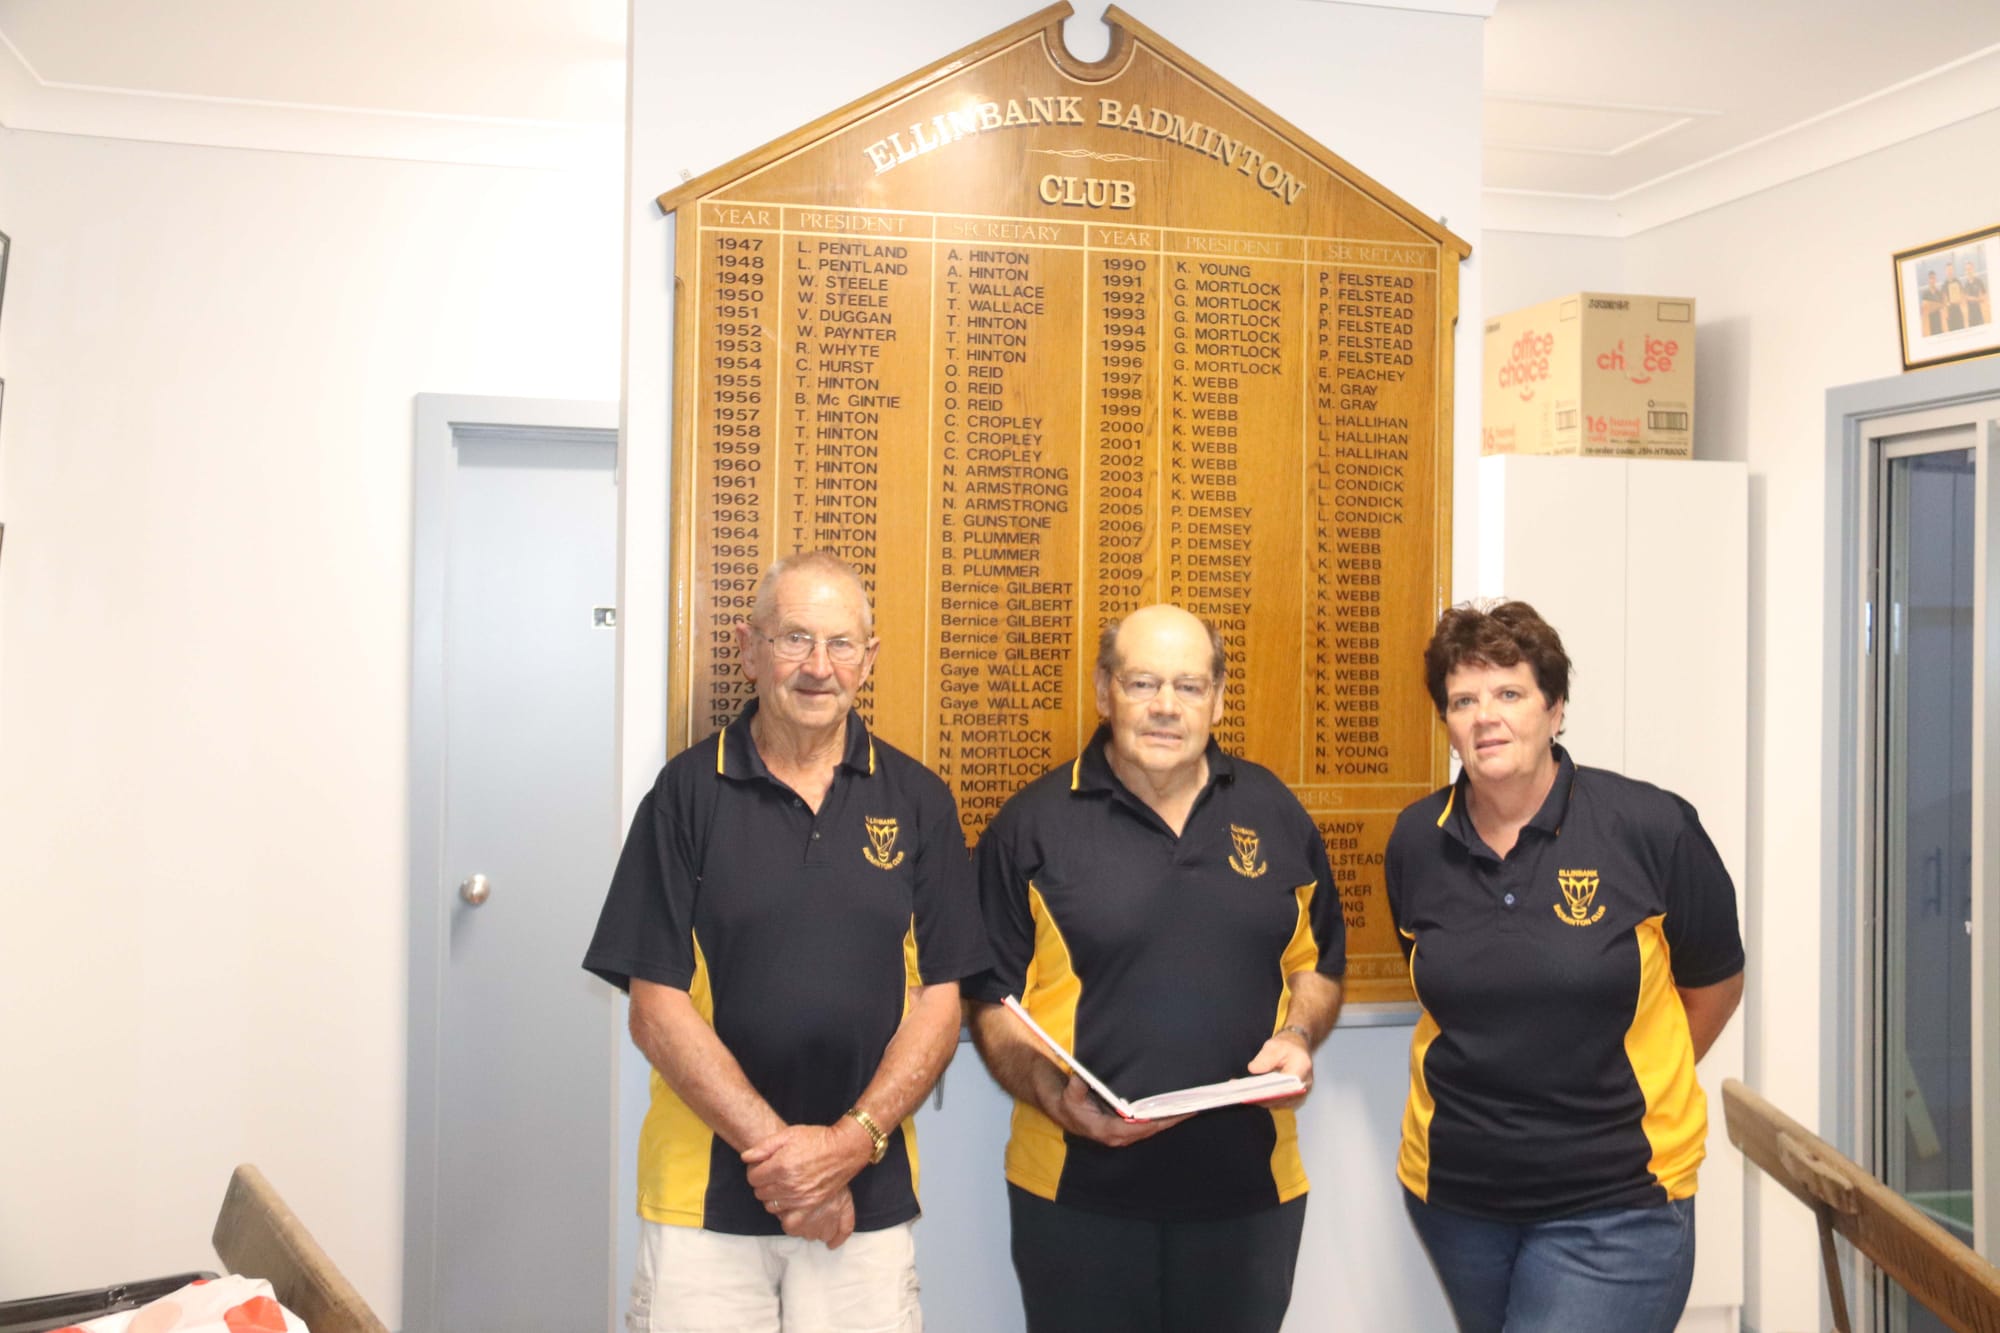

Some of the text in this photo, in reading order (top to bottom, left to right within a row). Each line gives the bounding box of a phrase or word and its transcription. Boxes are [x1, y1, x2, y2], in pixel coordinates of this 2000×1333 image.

[864, 96, 1306, 205] ELLINBANK BADMINTON
[1039, 174, 1137, 210] CLUB
[714, 207, 771, 226] YEAR
[800, 212, 908, 233] PRESIDENT
[952, 221, 1061, 241] SECRETARY
[716, 238, 763, 251] 1947
[1100, 229, 1151, 247] YEAR
[798, 241, 907, 259] L. PENTLAND
[1186, 234, 1284, 256] PRESIDENT
[948, 249, 1029, 265] A. HINTON
[1327, 245, 1427, 265] SECRETARY
[716, 255, 764, 269] 1948
[1103, 259, 1146, 271] 1990
[1177, 261, 1251, 278] K. YOUNG
[716, 272, 764, 285] 1949
[798, 275, 888, 291] W. STEELE
[1103, 275, 1141, 288] 1991
[947, 282, 1044, 299] T. WALLACE
[1174, 279, 1280, 296] G. MORTLOCK
[716, 288, 763, 302] 1950
[1103, 291, 1144, 304] 1992
[715, 305, 758, 319] 1951
[798, 308, 892, 324] V. DUGGAN
[1103, 308, 1146, 320] 1993
[1320, 303, 1413, 320] P. FELSTEAD
[946, 315, 1027, 330] T. HINTON
[715, 324, 762, 337] 1952
[797, 325, 896, 341] W. PAYNTER
[1104, 324, 1146, 336] 1994
[715, 339, 762, 353] 1953
[796, 342, 879, 357] R. WHYTE
[1102, 339, 1146, 352] 1995
[1512, 330, 1553, 362] office
[715, 357, 762, 370] 1954
[1102, 356, 1144, 368] 1996
[1319, 349, 1413, 365] P. FELSTEAD
[796, 358, 874, 373] C. HURST
[945, 364, 1003, 378] O. REID
[1102, 372, 1142, 384] 1997
[1319, 367, 1405, 382] E. PEACHEY
[1498, 357, 1549, 388] choice
[714, 374, 761, 387] 1955
[796, 376, 879, 391] T. HINTON
[1173, 376, 1238, 389] K. WEBB
[1101, 388, 1143, 400] 1998
[1319, 383, 1377, 395] M. GRAY
[714, 390, 761, 404] 1956
[795, 392, 900, 408] B. Mc GINTIE
[714, 408, 760, 421] 1957
[795, 409, 878, 424] T. HINTON
[1101, 404, 1141, 416] 1999
[944, 414, 1042, 429] C. CROPLEY
[1101, 421, 1144, 434] 2000
[1318, 415, 1408, 429] L. HALLIHAN
[1584, 415, 1608, 433] 16
[713, 424, 760, 437] 1958
[1173, 424, 1237, 437] K. WEBB
[713, 441, 760, 455] 1959
[795, 443, 878, 458] T. HINTON
[1101, 438, 1140, 450] 2001
[713, 458, 761, 472] 1960
[1100, 454, 1143, 467] 2002
[943, 464, 1068, 480] N. ARMSTRONG
[1100, 470, 1143, 482] 2003
[712, 475, 755, 488] 1961
[1172, 473, 1237, 486] K. WEBB
[1318, 479, 1403, 492] L. CONDICK
[1100, 487, 1143, 498] 2004
[712, 493, 759, 506] 1962
[1100, 503, 1143, 515] 2005
[1172, 506, 1252, 518] P. DEMSEY
[712, 510, 759, 522] 1963
[943, 514, 1051, 528] E. GUNSTONE
[1099, 520, 1143, 532] 2006
[712, 527, 759, 539] 1964
[942, 530, 1040, 544] B. PLUMMER
[1318, 527, 1381, 539] K. WEBB
[1099, 536, 1142, 547] 2007
[712, 545, 759, 557] 1965
[1099, 552, 1142, 564] 2008
[1171, 554, 1251, 567] P. DEMSEY
[712, 562, 758, 575] 1966
[1099, 568, 1143, 580] 2009
[712, 579, 757, 591] 1967
[942, 580, 1072, 594] Bernice GILBERT
[1099, 584, 1141, 596] 2010
[1171, 586, 1251, 598] P. DEMSEY
[1100, 601, 1138, 612] 2011
[1317, 606, 1380, 617] K. WEBB
[941, 631, 1072, 644] Bernice GILBERT
[941, 664, 1062, 678] Gaye WALLACE
[711, 681, 756, 694] 1973
[940, 730, 1051, 743] N. MORTLOCK
[1316, 746, 1388, 757] N. YOUNG
